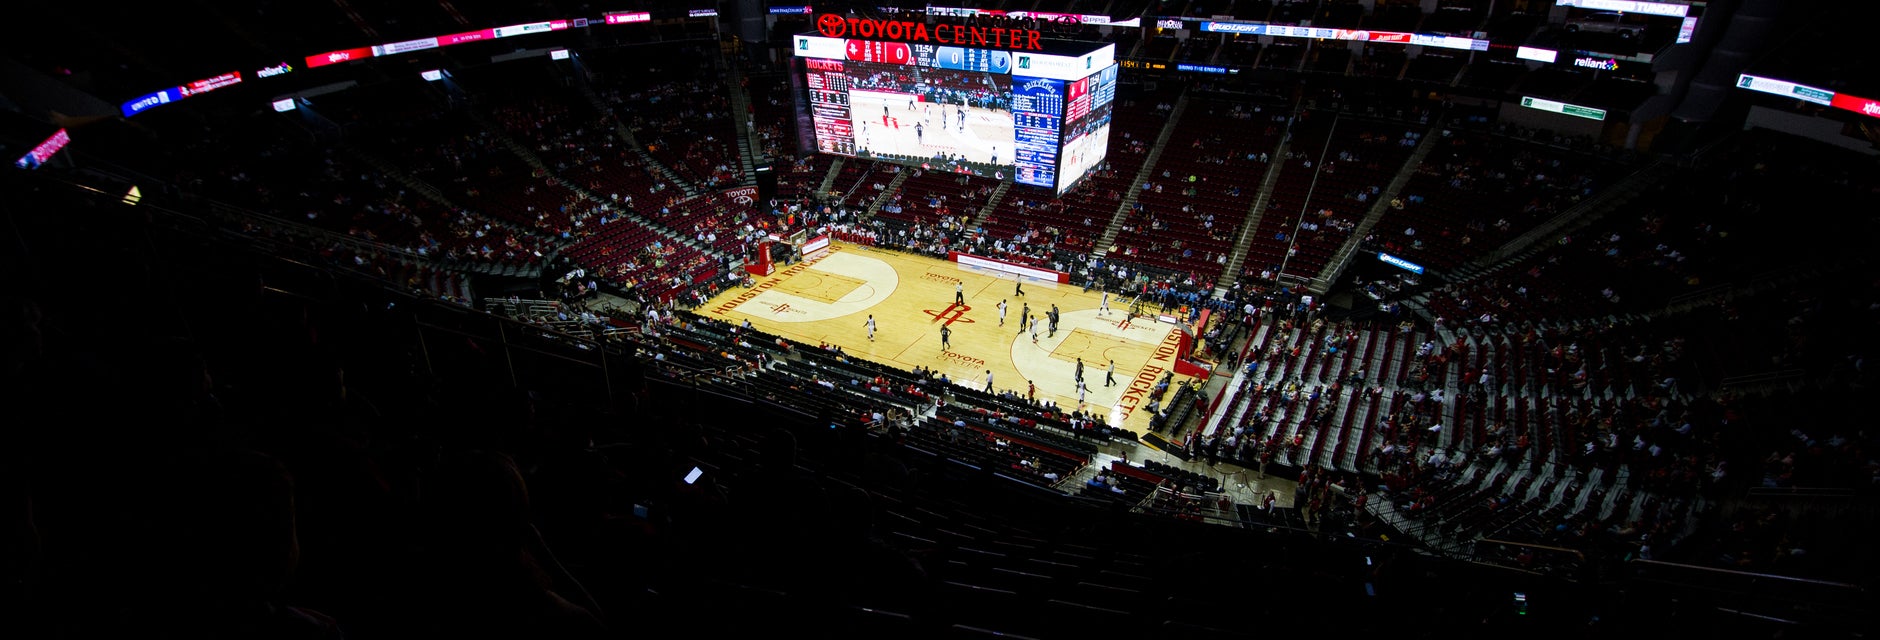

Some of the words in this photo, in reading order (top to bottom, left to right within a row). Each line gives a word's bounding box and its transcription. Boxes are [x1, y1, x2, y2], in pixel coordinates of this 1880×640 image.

[1637, 3, 1684, 16] TUNDRA
[847, 17, 929, 43] TOYOTA
[934, 23, 1043, 51] CENTER
[1232, 24, 1260, 33] LIGHT
[896, 48, 903, 59] 0
[915, 44, 933, 54] 11:54
[951, 52, 958, 64] 0
[1574, 57, 1607, 70] reliant
[806, 58, 844, 72] ROCKETS
[1023, 79, 1056, 94] GRIZZLIES
[131, 96, 159, 111] UNITED
[726, 188, 756, 198] TOYOTA
[1398, 260, 1422, 271] LIGHT
[711, 277, 782, 315] HOUSTON
[781, 245, 842, 277] ROCKETS
[925, 272, 961, 283] TOYOTA
[936, 354, 982, 370] CENTER
[942, 350, 986, 365] TOYOTA
